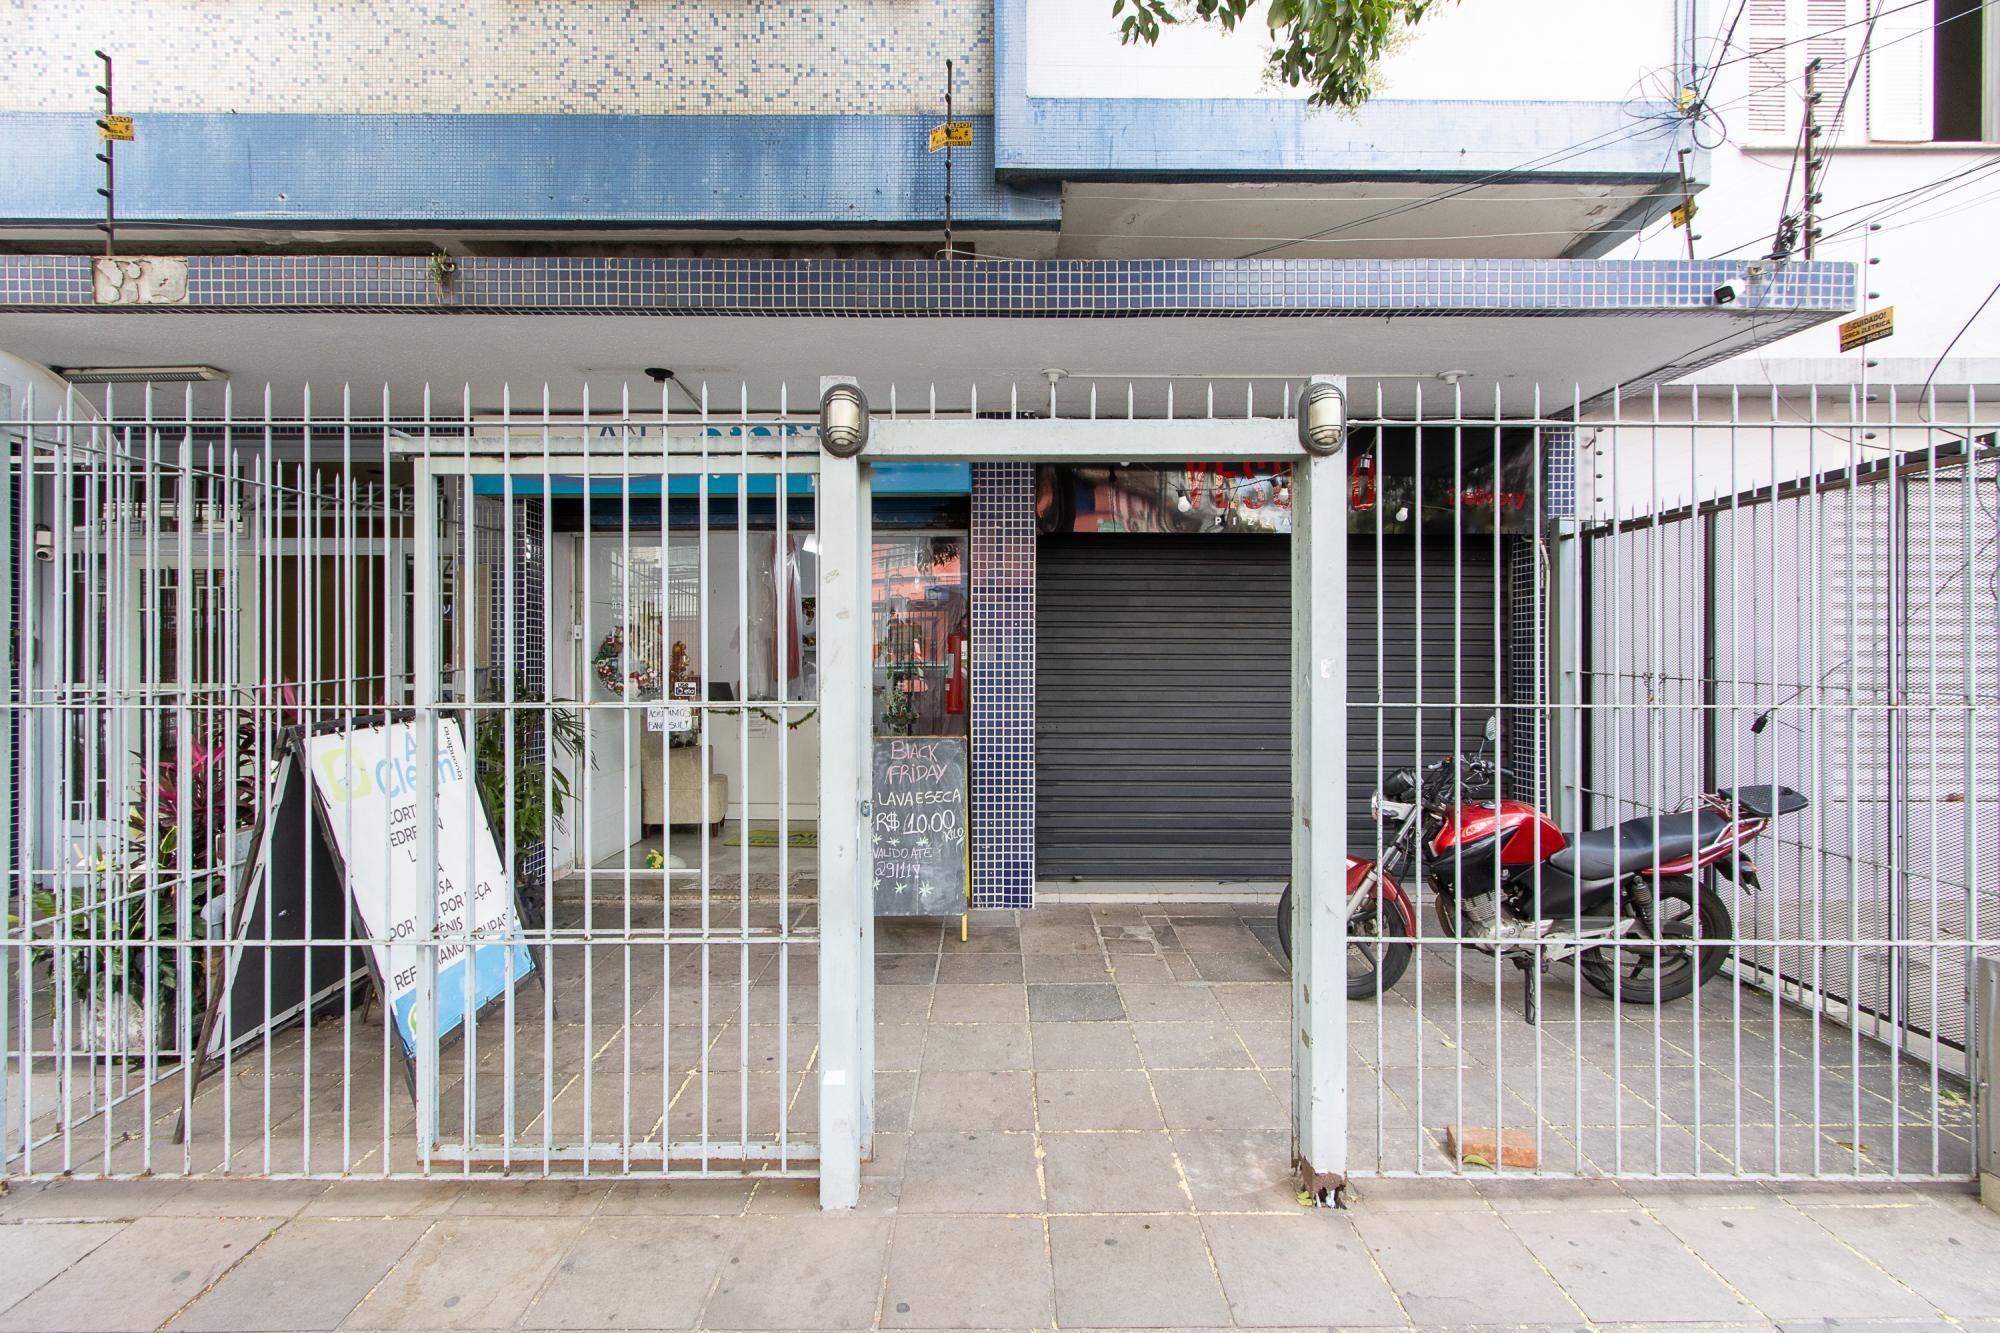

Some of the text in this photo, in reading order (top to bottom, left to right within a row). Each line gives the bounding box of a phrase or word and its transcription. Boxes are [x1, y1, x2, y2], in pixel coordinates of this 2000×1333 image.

[1186, 456, 1375, 511] VESUO
[878, 788, 962, 807] LAVA E SECA
[876, 811, 900, 832] R$
[440, 894, 464, 916] POR
